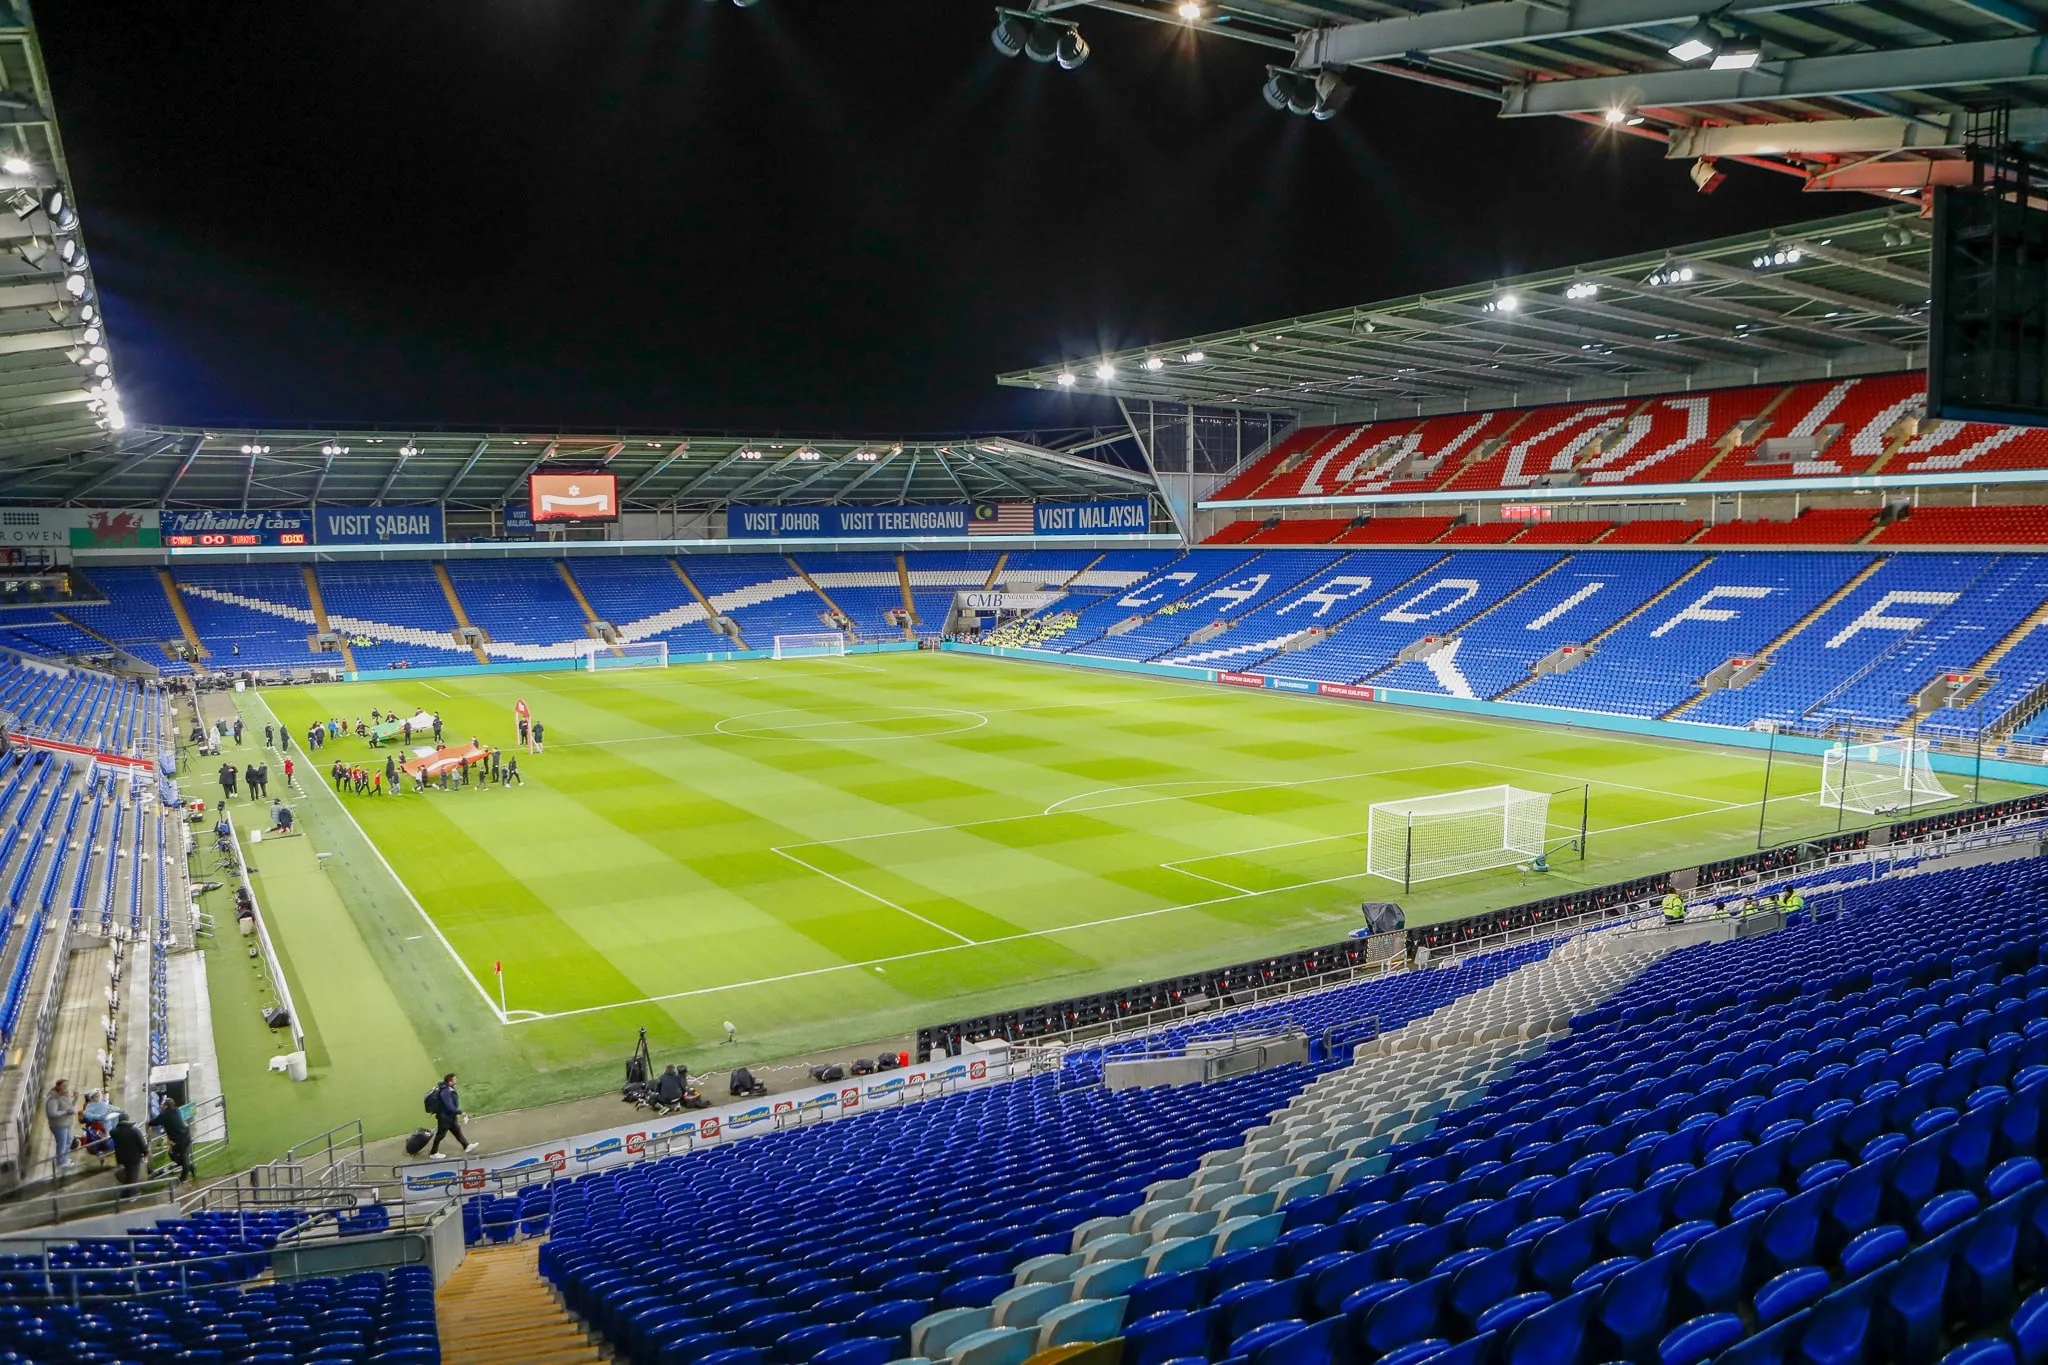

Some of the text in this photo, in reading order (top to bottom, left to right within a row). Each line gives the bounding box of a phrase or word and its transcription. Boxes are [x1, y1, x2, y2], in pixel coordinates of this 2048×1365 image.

[173, 513, 301, 531] Nathaniel cars
[329, 515, 430, 536] VISIT SABAH
[507, 519, 534, 527] MALAYSI
[744, 512, 820, 530] VISIT JOHOR
[841, 511, 964, 530] VISIT TERENGGANU
[1039, 505, 1145, 529] VISIT MALAYSIA
[967, 593, 1003, 607] CMB
[1327, 686, 1370, 697] EUROPEAN QUALIFIERS
